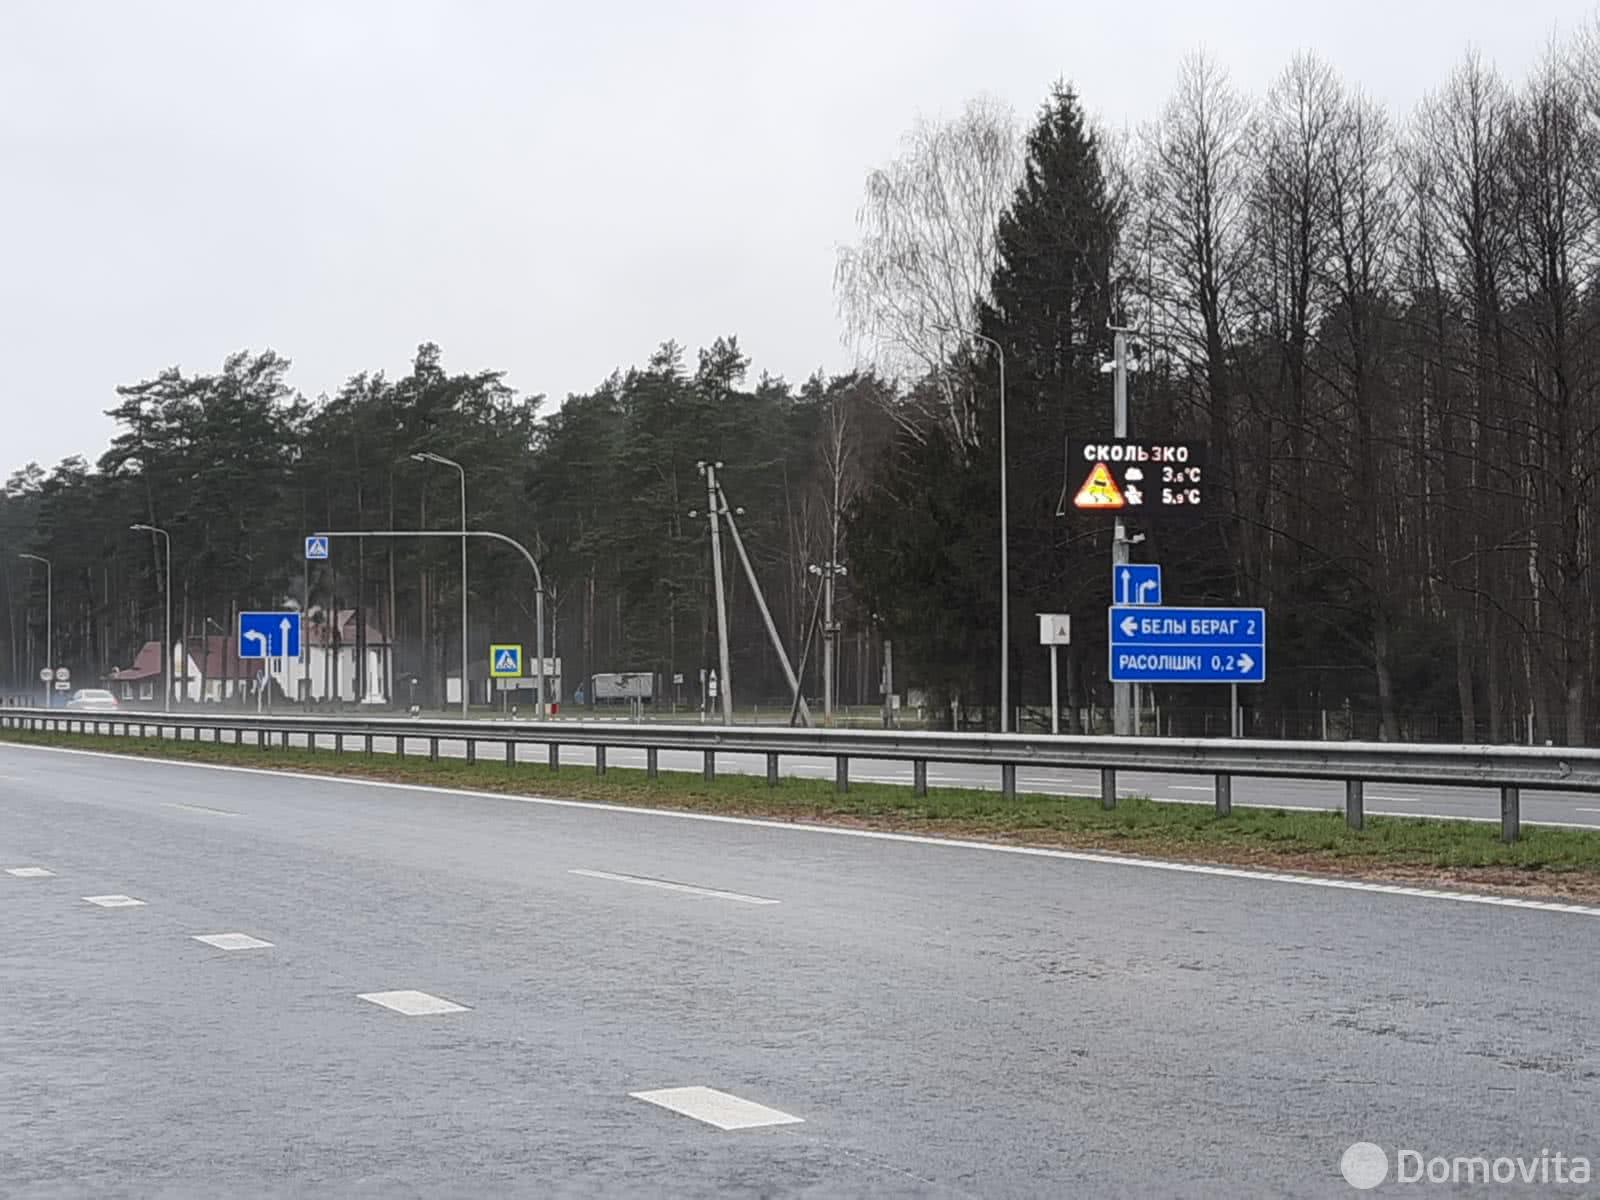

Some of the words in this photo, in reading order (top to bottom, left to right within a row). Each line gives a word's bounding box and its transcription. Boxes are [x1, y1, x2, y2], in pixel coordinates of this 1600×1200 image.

[1083, 444, 1189, 462] СКОЛЬЗКО
[1141, 618, 1187, 634] БЕЛЫ
[1191, 619, 1240, 635] БЕРАГ
[1246, 620, 1256, 635] 2
[1119, 655, 1202, 671] РАСОЛІШКІ
[1211, 655, 1235, 673] 0,2
